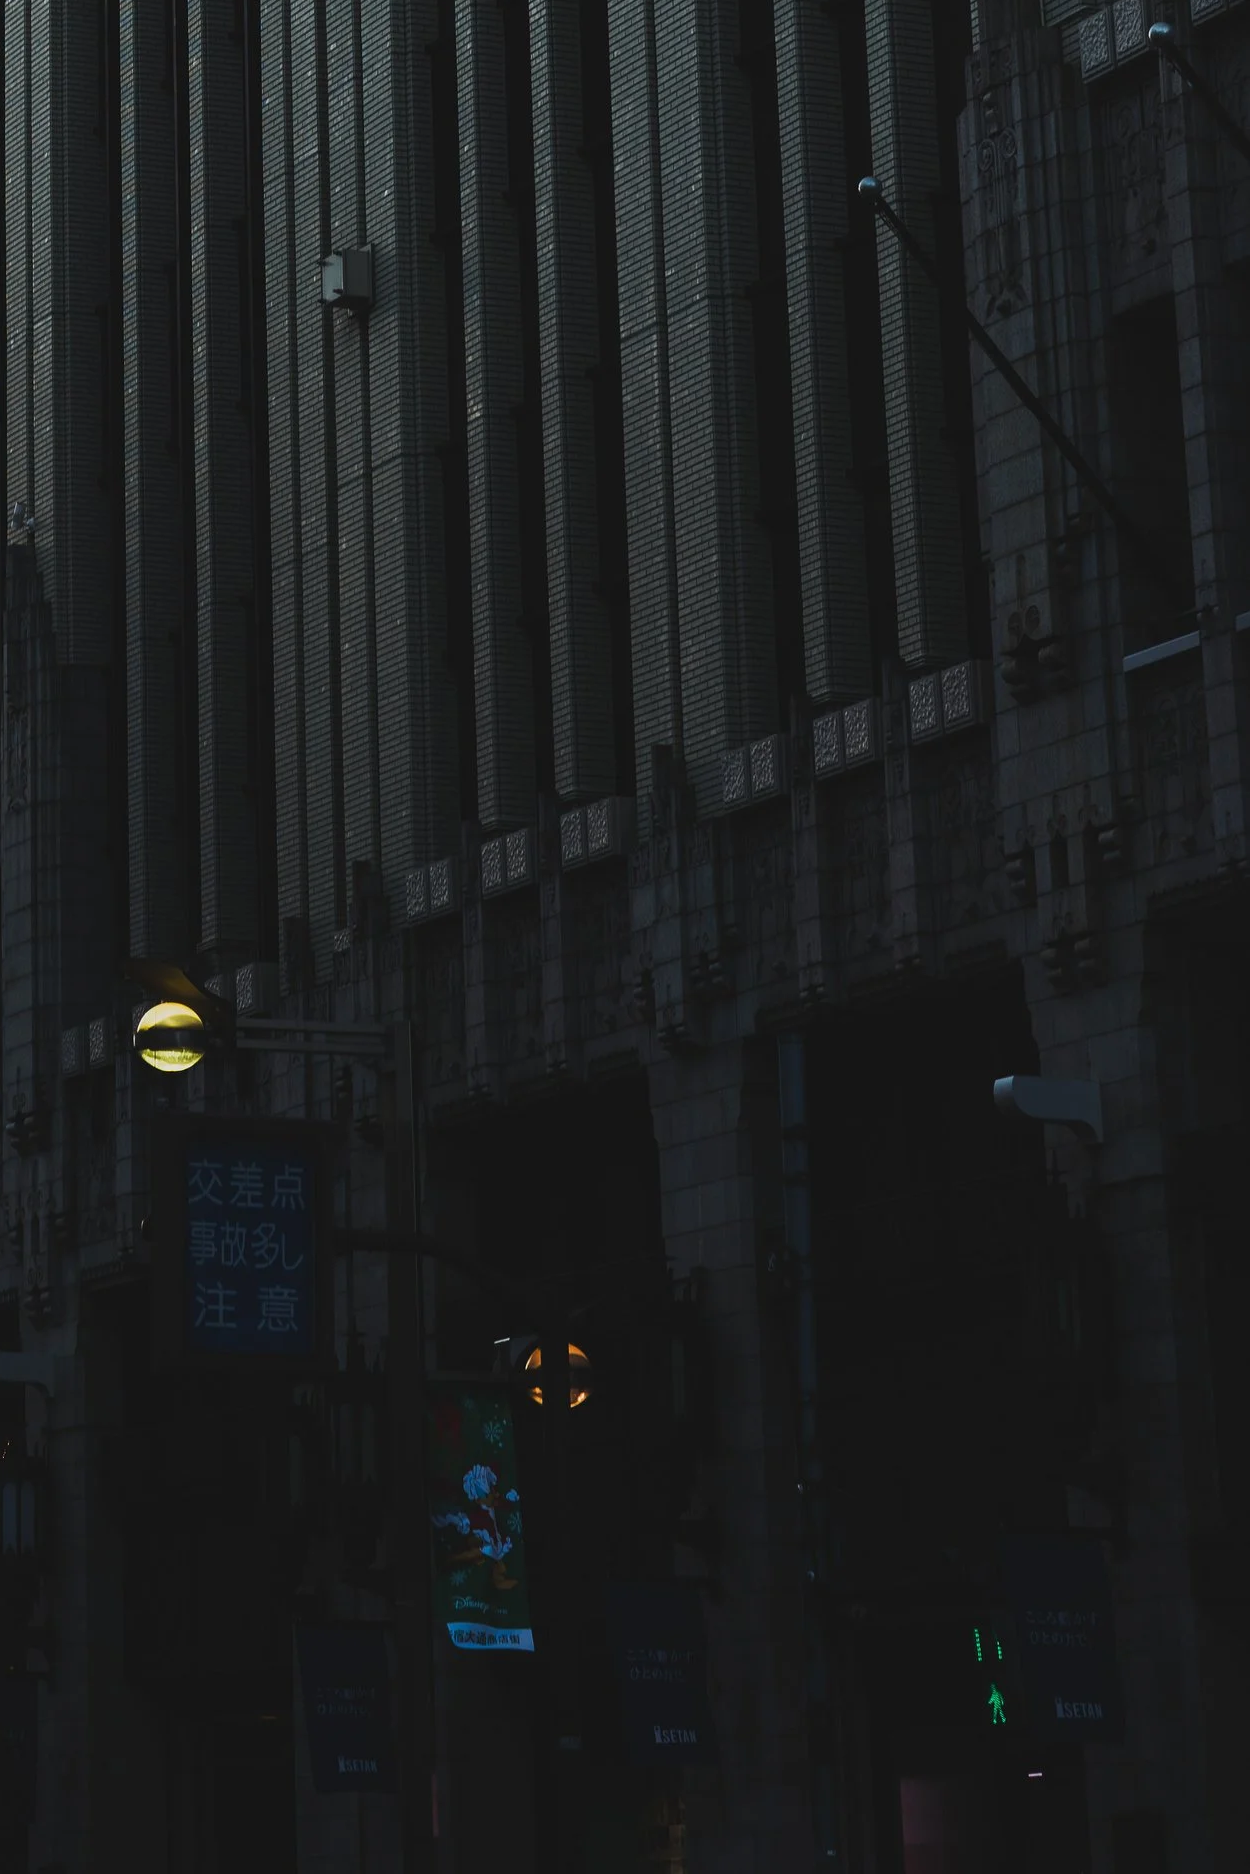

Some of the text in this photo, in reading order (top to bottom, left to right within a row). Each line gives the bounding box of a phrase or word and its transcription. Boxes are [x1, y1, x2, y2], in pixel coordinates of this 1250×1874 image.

[188, 1158, 306, 1211] 交差点
[188, 1219, 305, 1271] 事故多し
[193, 1280, 299, 1334] 注意
